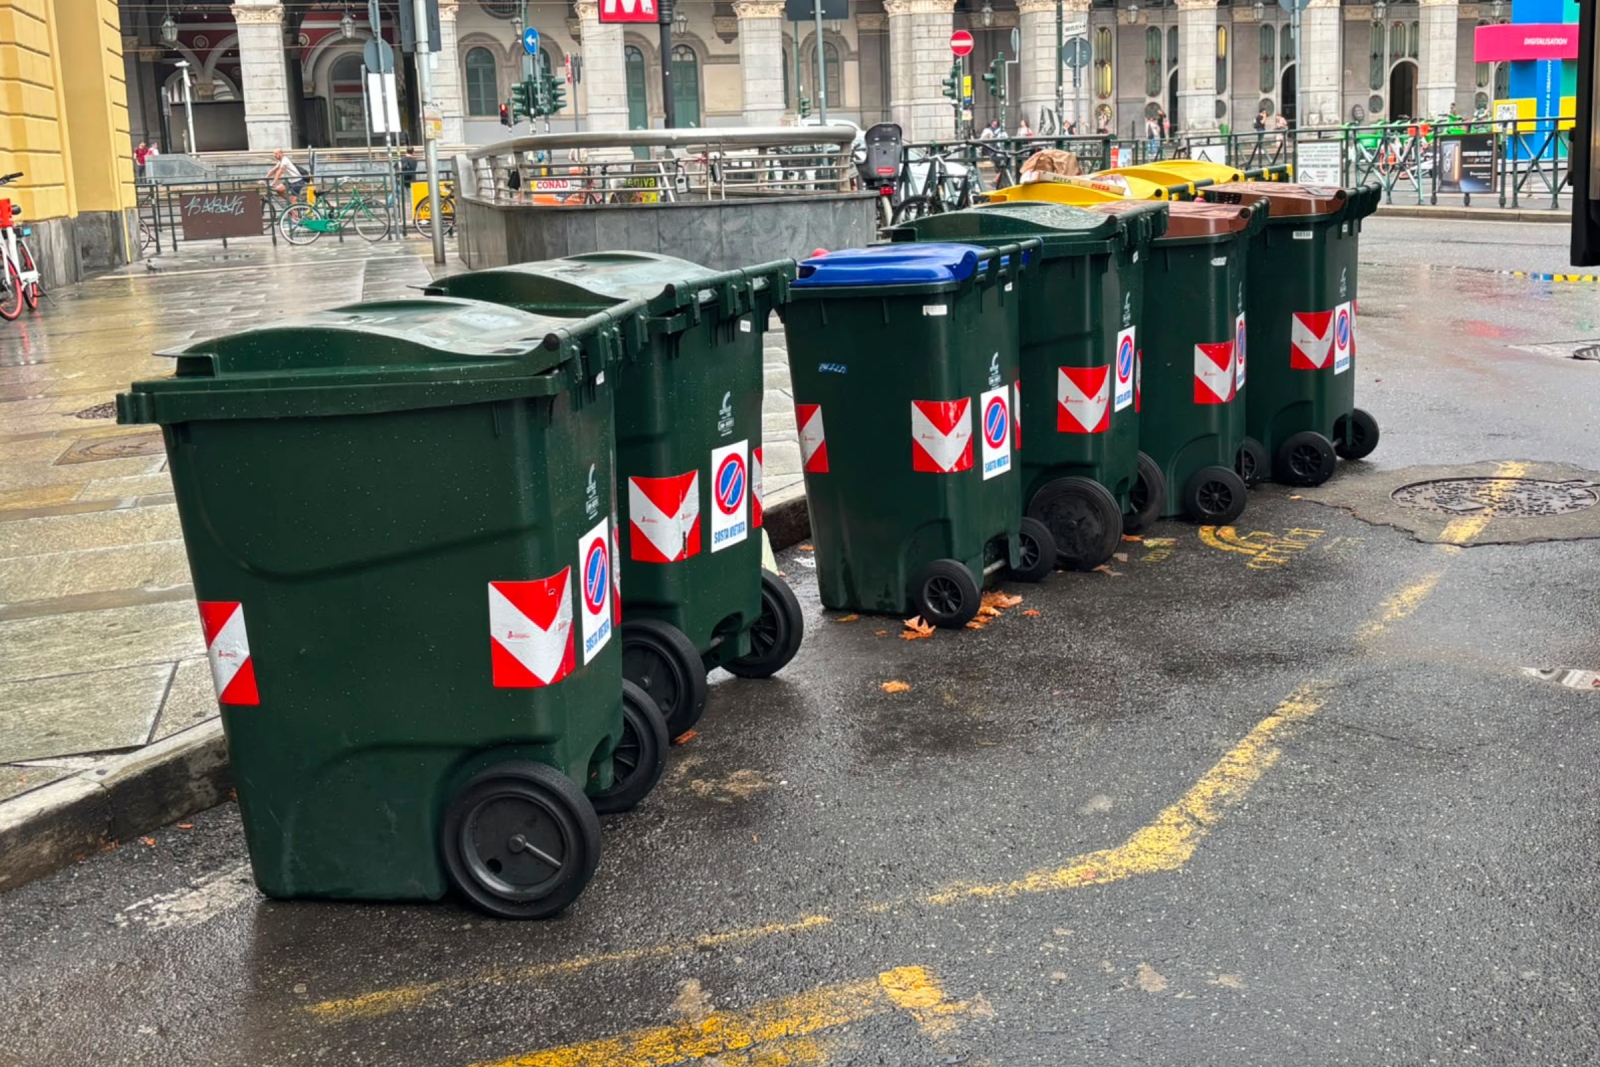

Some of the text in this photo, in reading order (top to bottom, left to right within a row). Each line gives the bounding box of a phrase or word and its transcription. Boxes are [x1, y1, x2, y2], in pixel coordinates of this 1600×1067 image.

[1523, 37, 1568, 46] DIGITALISATION
[1053, 176, 1072, 184] PIZZA
[536, 180, 569, 190] CONAD
[1091, 183, 1111, 191] PIZZA
[714, 520, 746, 544] SOSTA VIETATA
[586, 617, 610, 653] SOSTA VIETATA
